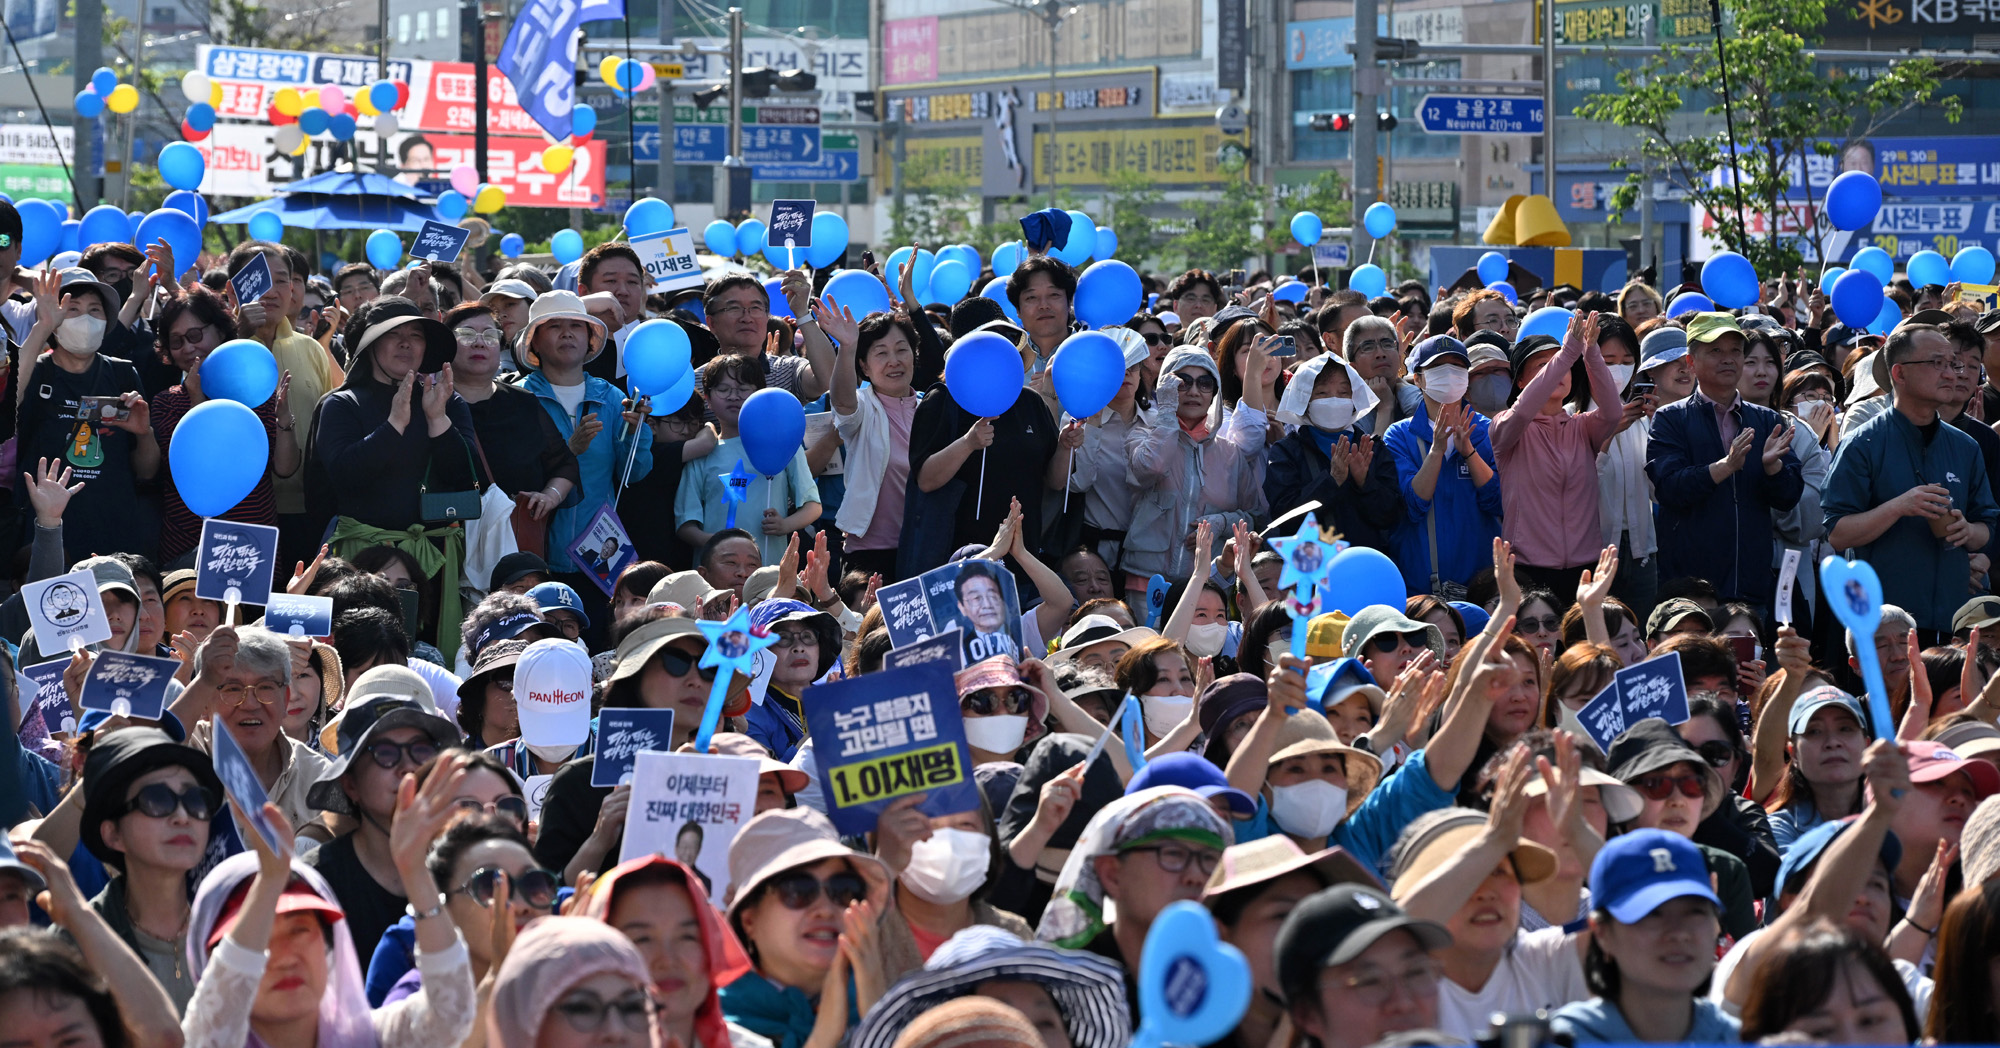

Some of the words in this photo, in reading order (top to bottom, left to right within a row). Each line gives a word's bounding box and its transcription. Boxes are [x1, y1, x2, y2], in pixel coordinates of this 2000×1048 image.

[213, 51, 304, 81] 삼권장악
[814, 52, 862, 77] 키즈
[1427, 108, 1440, 120] 12
[1455, 99, 1513, 118] 늘을2로
[1530, 109, 1543, 122] 16
[1446, 119, 1486, 130] Neureul
[674, 128, 711, 147] 안로
[1879, 163, 1977, 186] 사전투표로
[1881, 206, 1962, 230] 사전투표
[662, 237, 678, 257] 1
[646, 254, 693, 275] 이재명
[557, 587, 573, 606] LA
[930, 580, 956, 596] 민주당
[529, 689, 584, 705] PANTHEON
[834, 704, 871, 731] 누구
[838, 719, 909, 757] 고민될
[909, 713, 938, 741] 땐
[666, 774, 729, 797] 이제부터
[646, 801, 677, 822] 진짜
[680, 801, 741, 824] 대한민국
[1649, 847, 1676, 873] R
